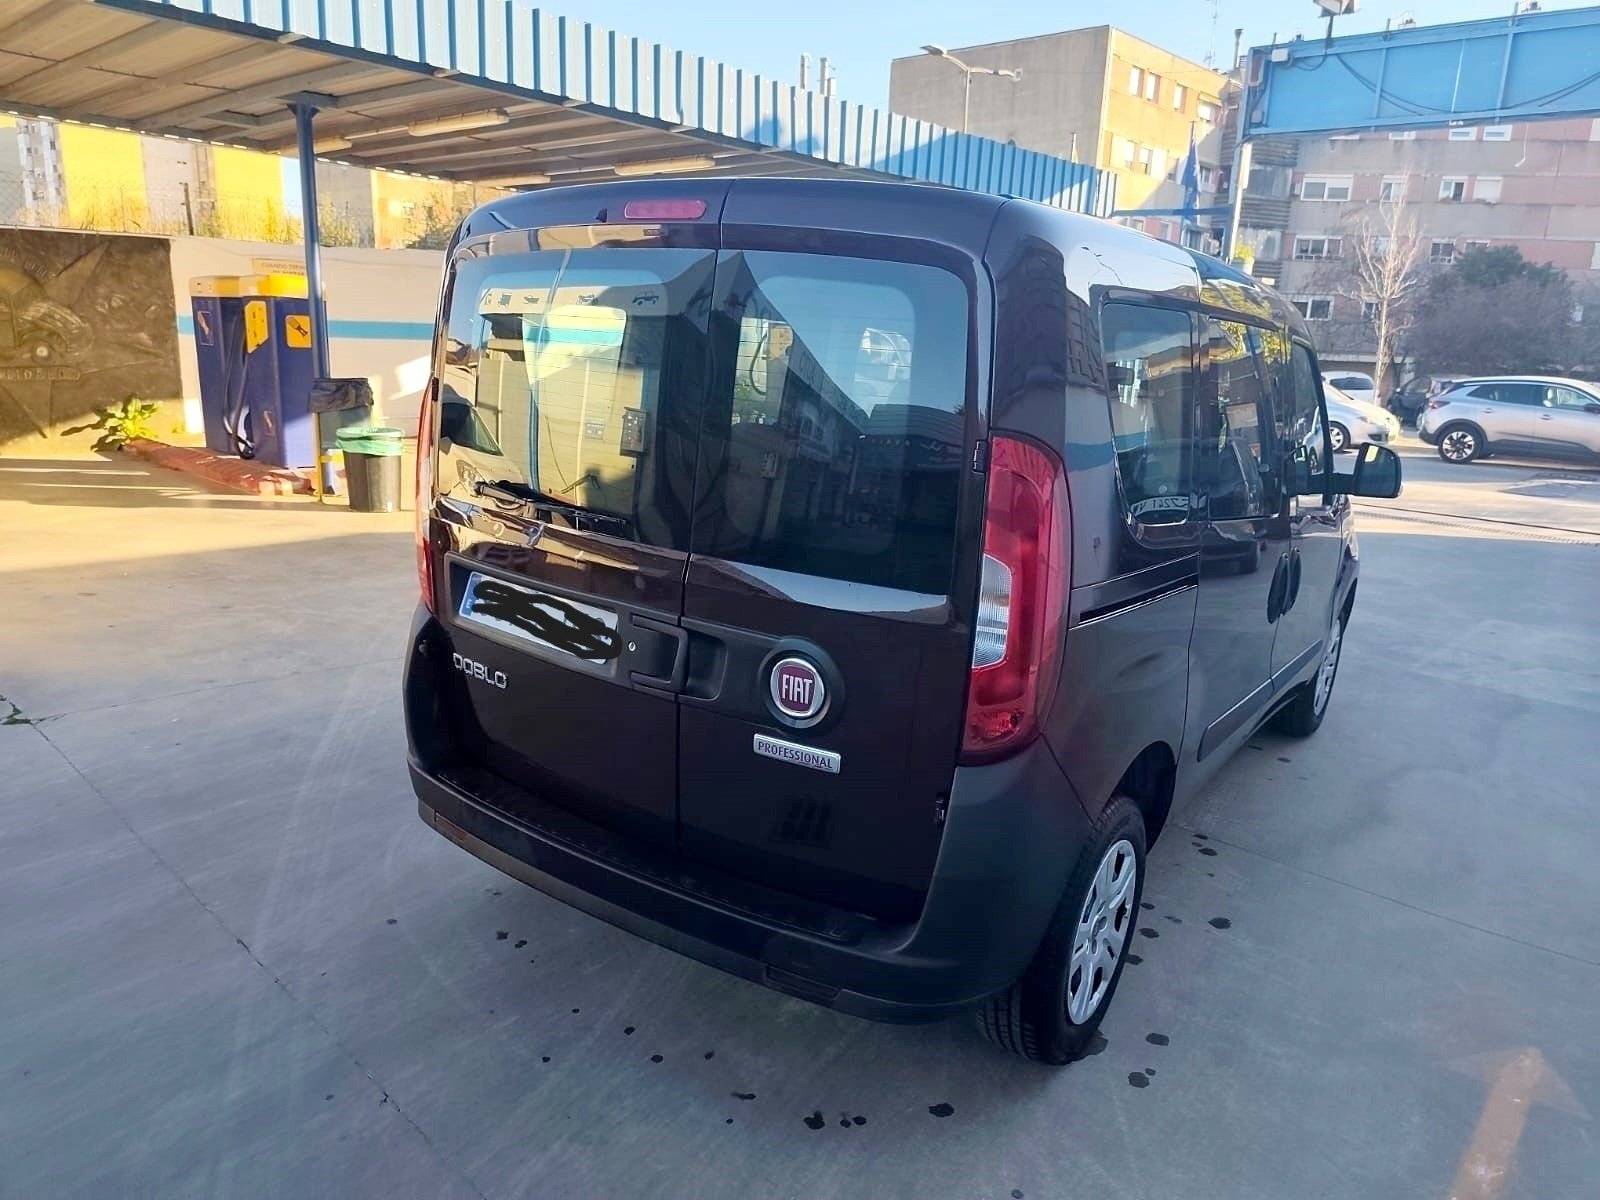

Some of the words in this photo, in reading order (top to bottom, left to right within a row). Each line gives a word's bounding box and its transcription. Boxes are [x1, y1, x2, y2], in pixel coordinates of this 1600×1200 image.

[452, 652, 507, 689] DOBLO
[781, 674, 813, 704] FIAT
[758, 741, 833, 769] PROFESSIONAL
